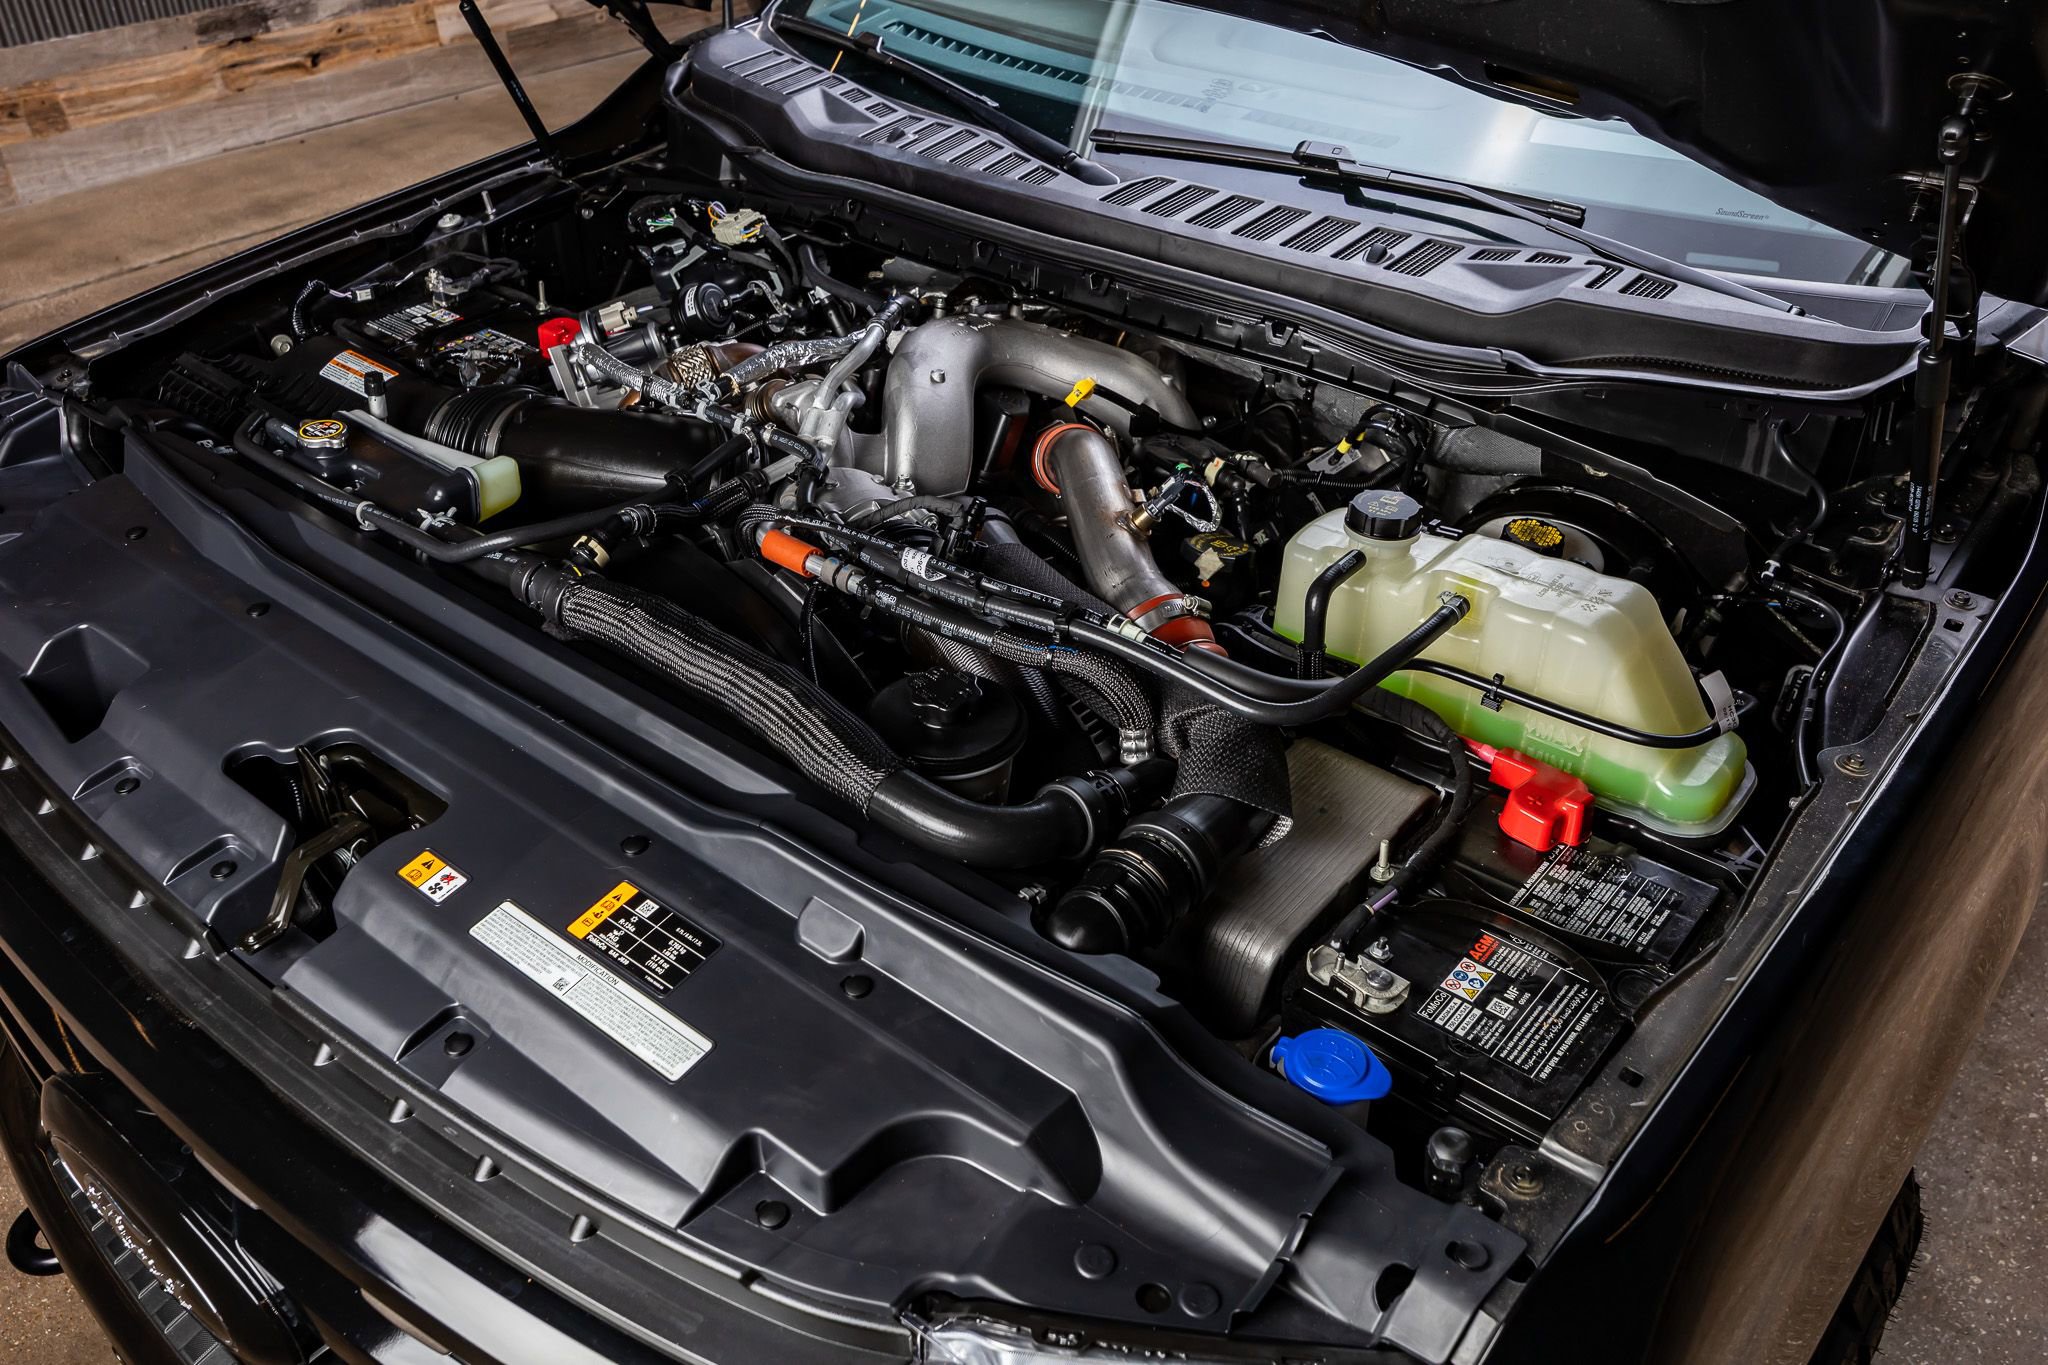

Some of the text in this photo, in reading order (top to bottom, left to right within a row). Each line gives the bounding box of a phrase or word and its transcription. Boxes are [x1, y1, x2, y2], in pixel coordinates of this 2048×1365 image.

[618, 919, 635, 932] R-134a
[587, 935, 607, 950] FoMoCo
[607, 933, 619, 942] PAG
[1470, 935, 1495, 960] AGM
[577, 955, 619, 985] MODIFICATION
[1504, 986, 1519, 1000] MF
[1421, 991, 1447, 1018] FoMoCo
